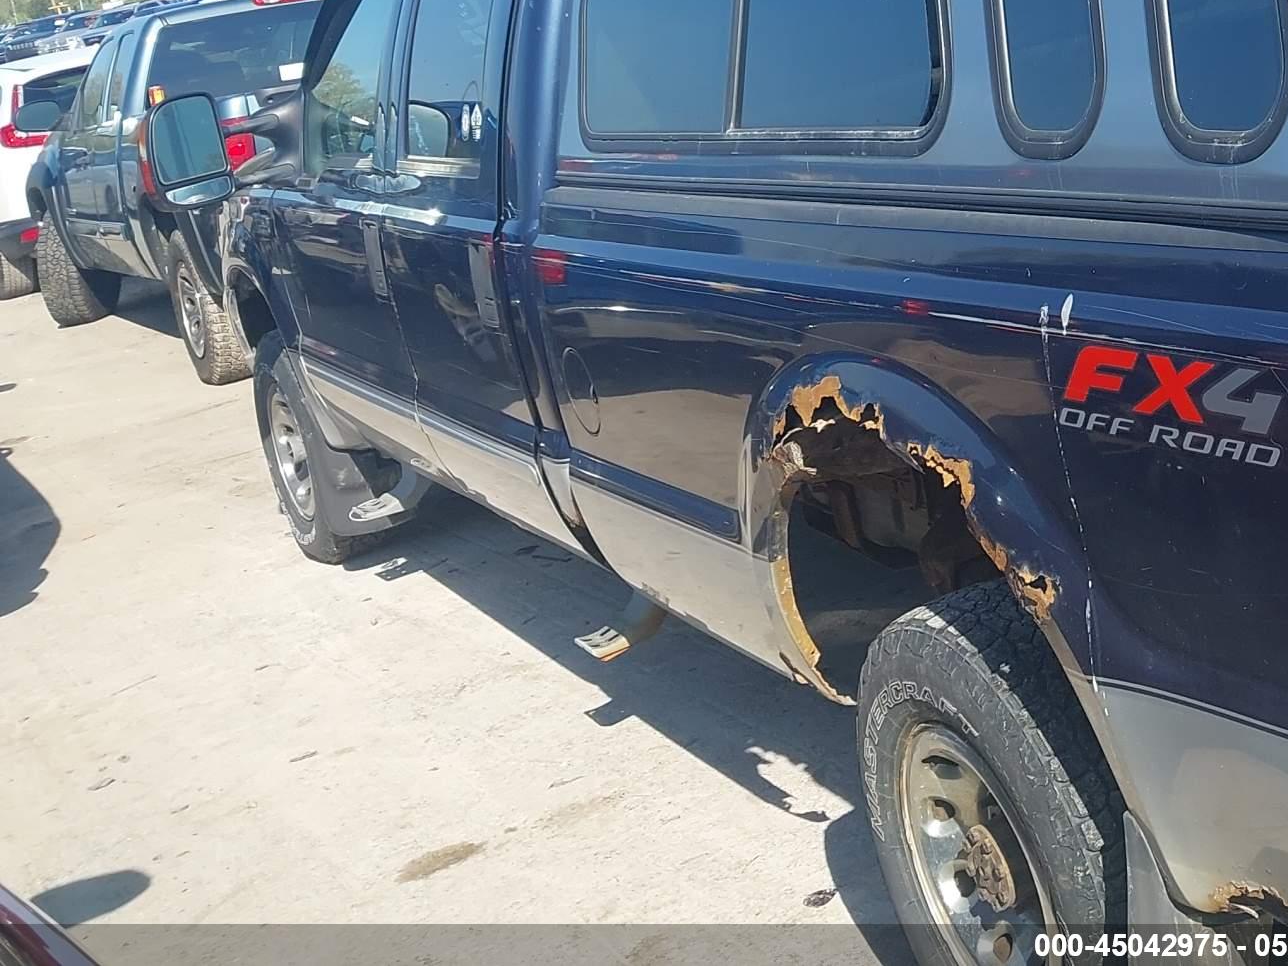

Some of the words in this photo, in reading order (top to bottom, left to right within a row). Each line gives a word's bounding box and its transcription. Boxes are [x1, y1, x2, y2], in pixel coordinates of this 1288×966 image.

[1063, 345, 1283, 434] FX4
[1059, 407, 1135, 434] OFF
[1149, 424, 1281, 467] ROAD
[863, 681, 980, 842] MASTERCRAFT
